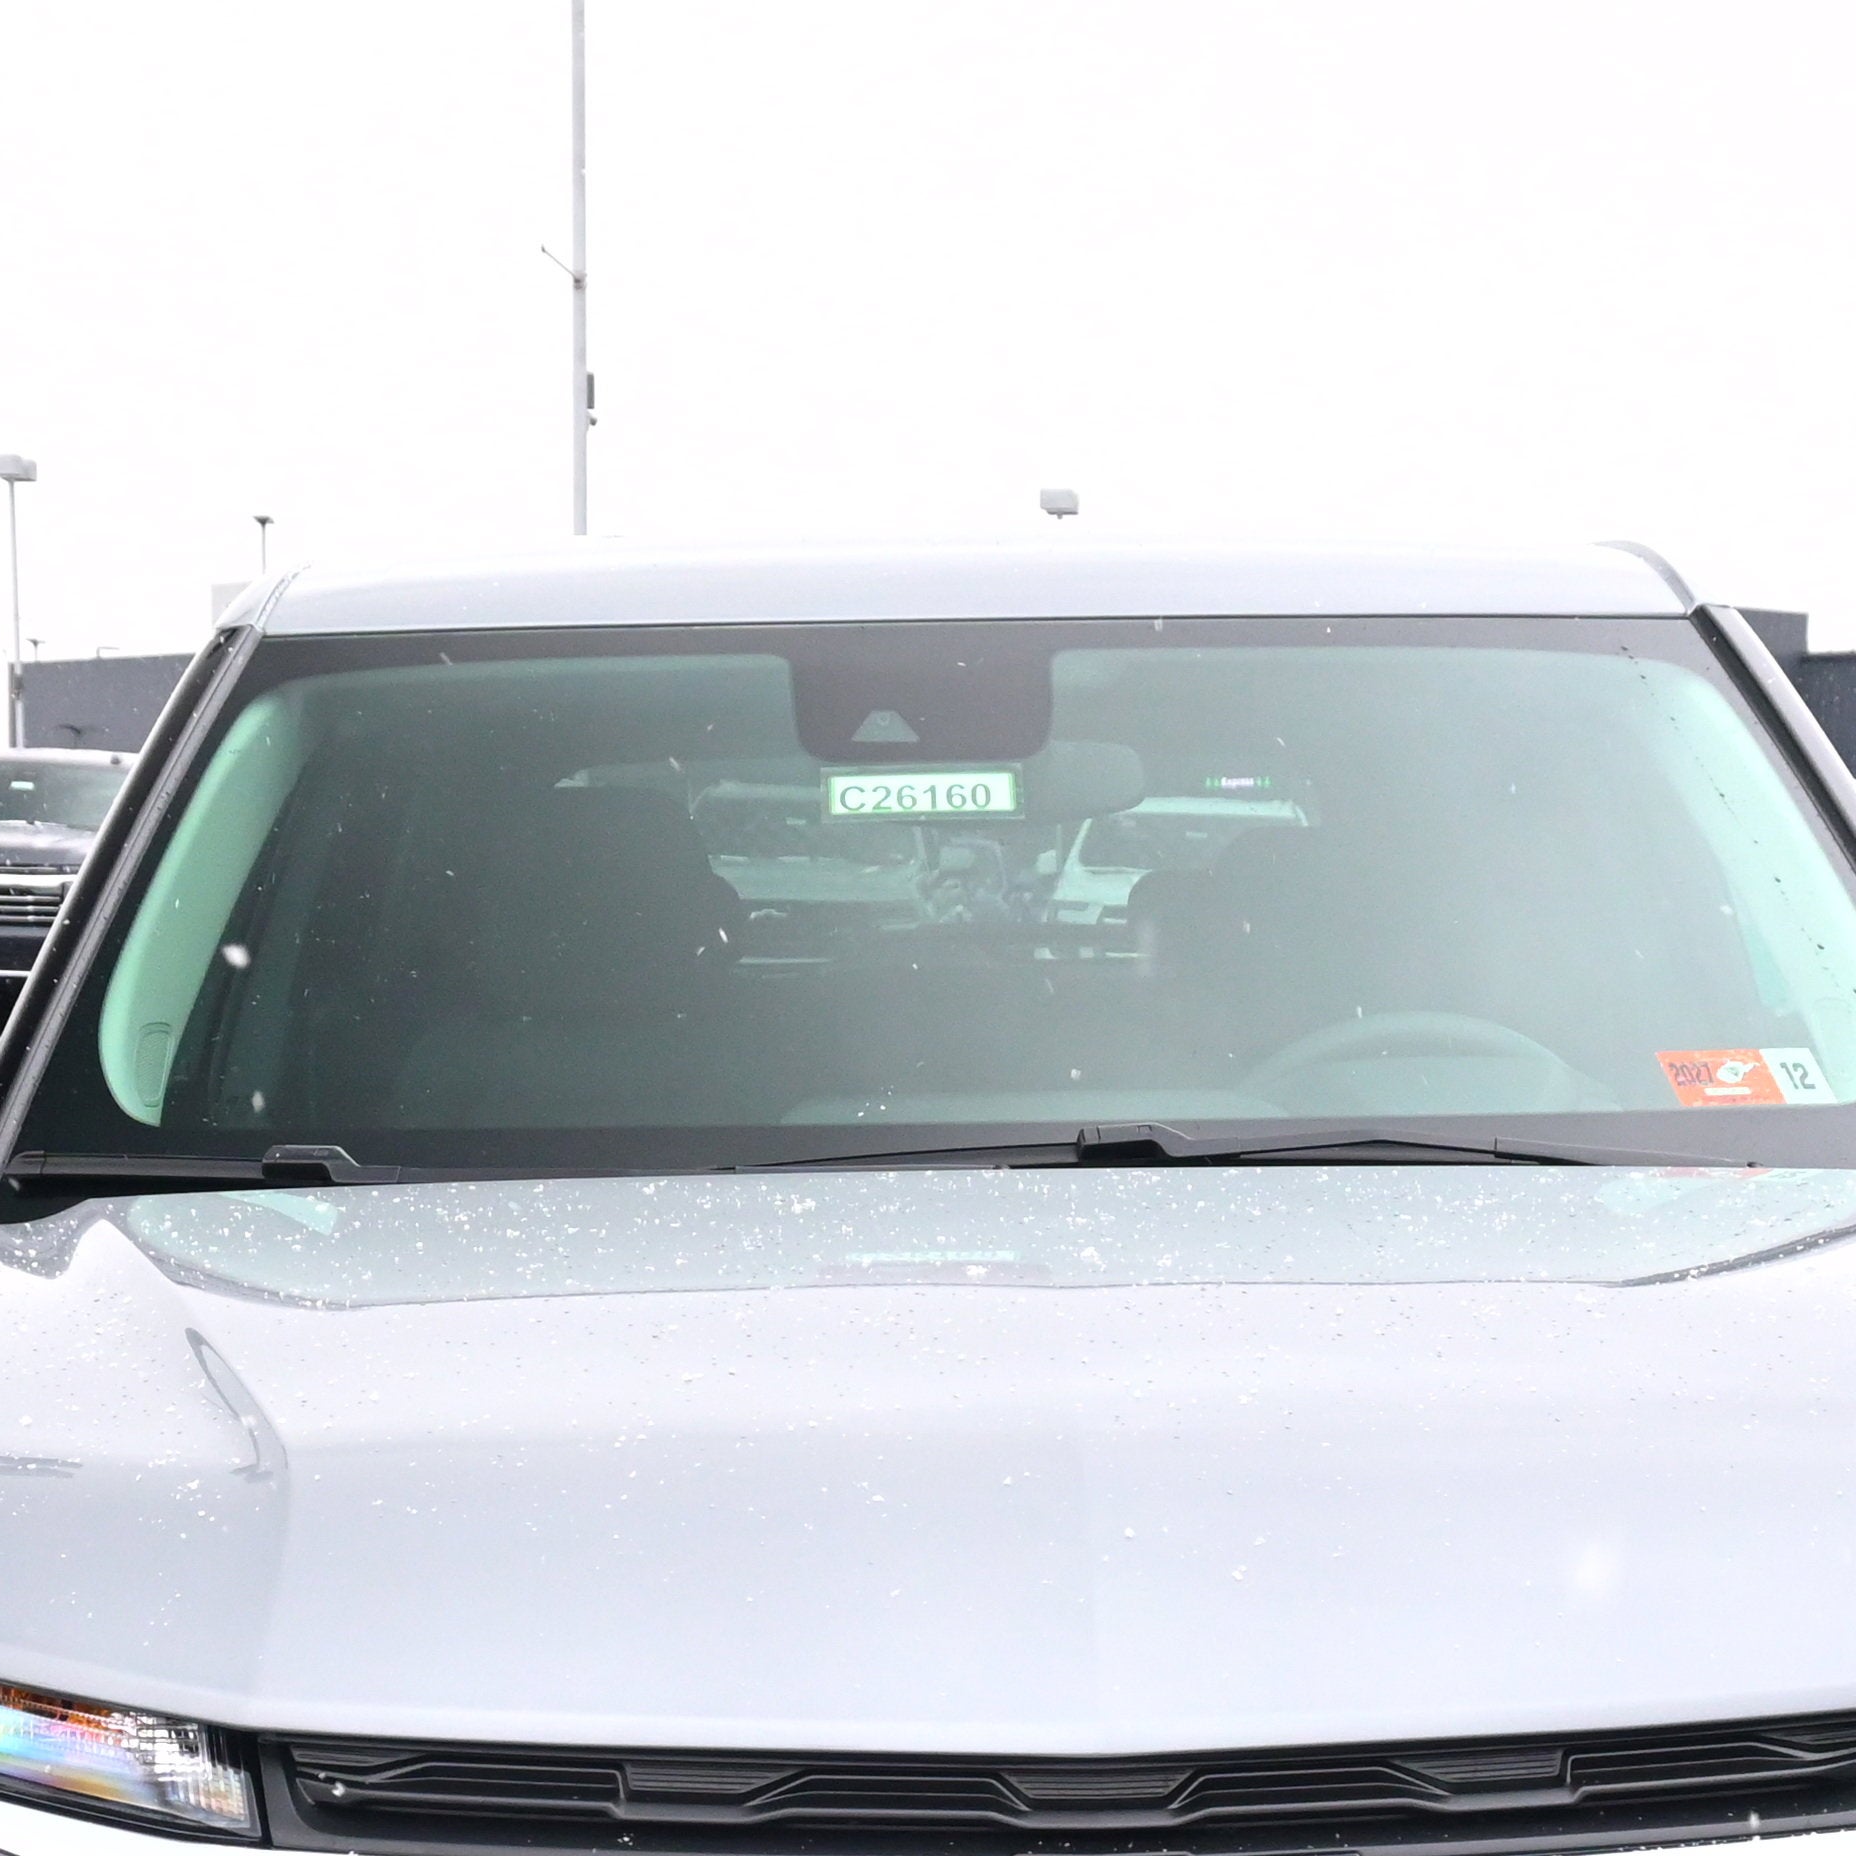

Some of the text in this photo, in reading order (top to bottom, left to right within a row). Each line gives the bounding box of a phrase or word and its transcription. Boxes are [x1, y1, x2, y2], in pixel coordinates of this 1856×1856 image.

[839, 783, 991, 811] C26160
[1669, 1061, 1714, 1086] 2027
[1780, 1061, 1816, 1090] 12
